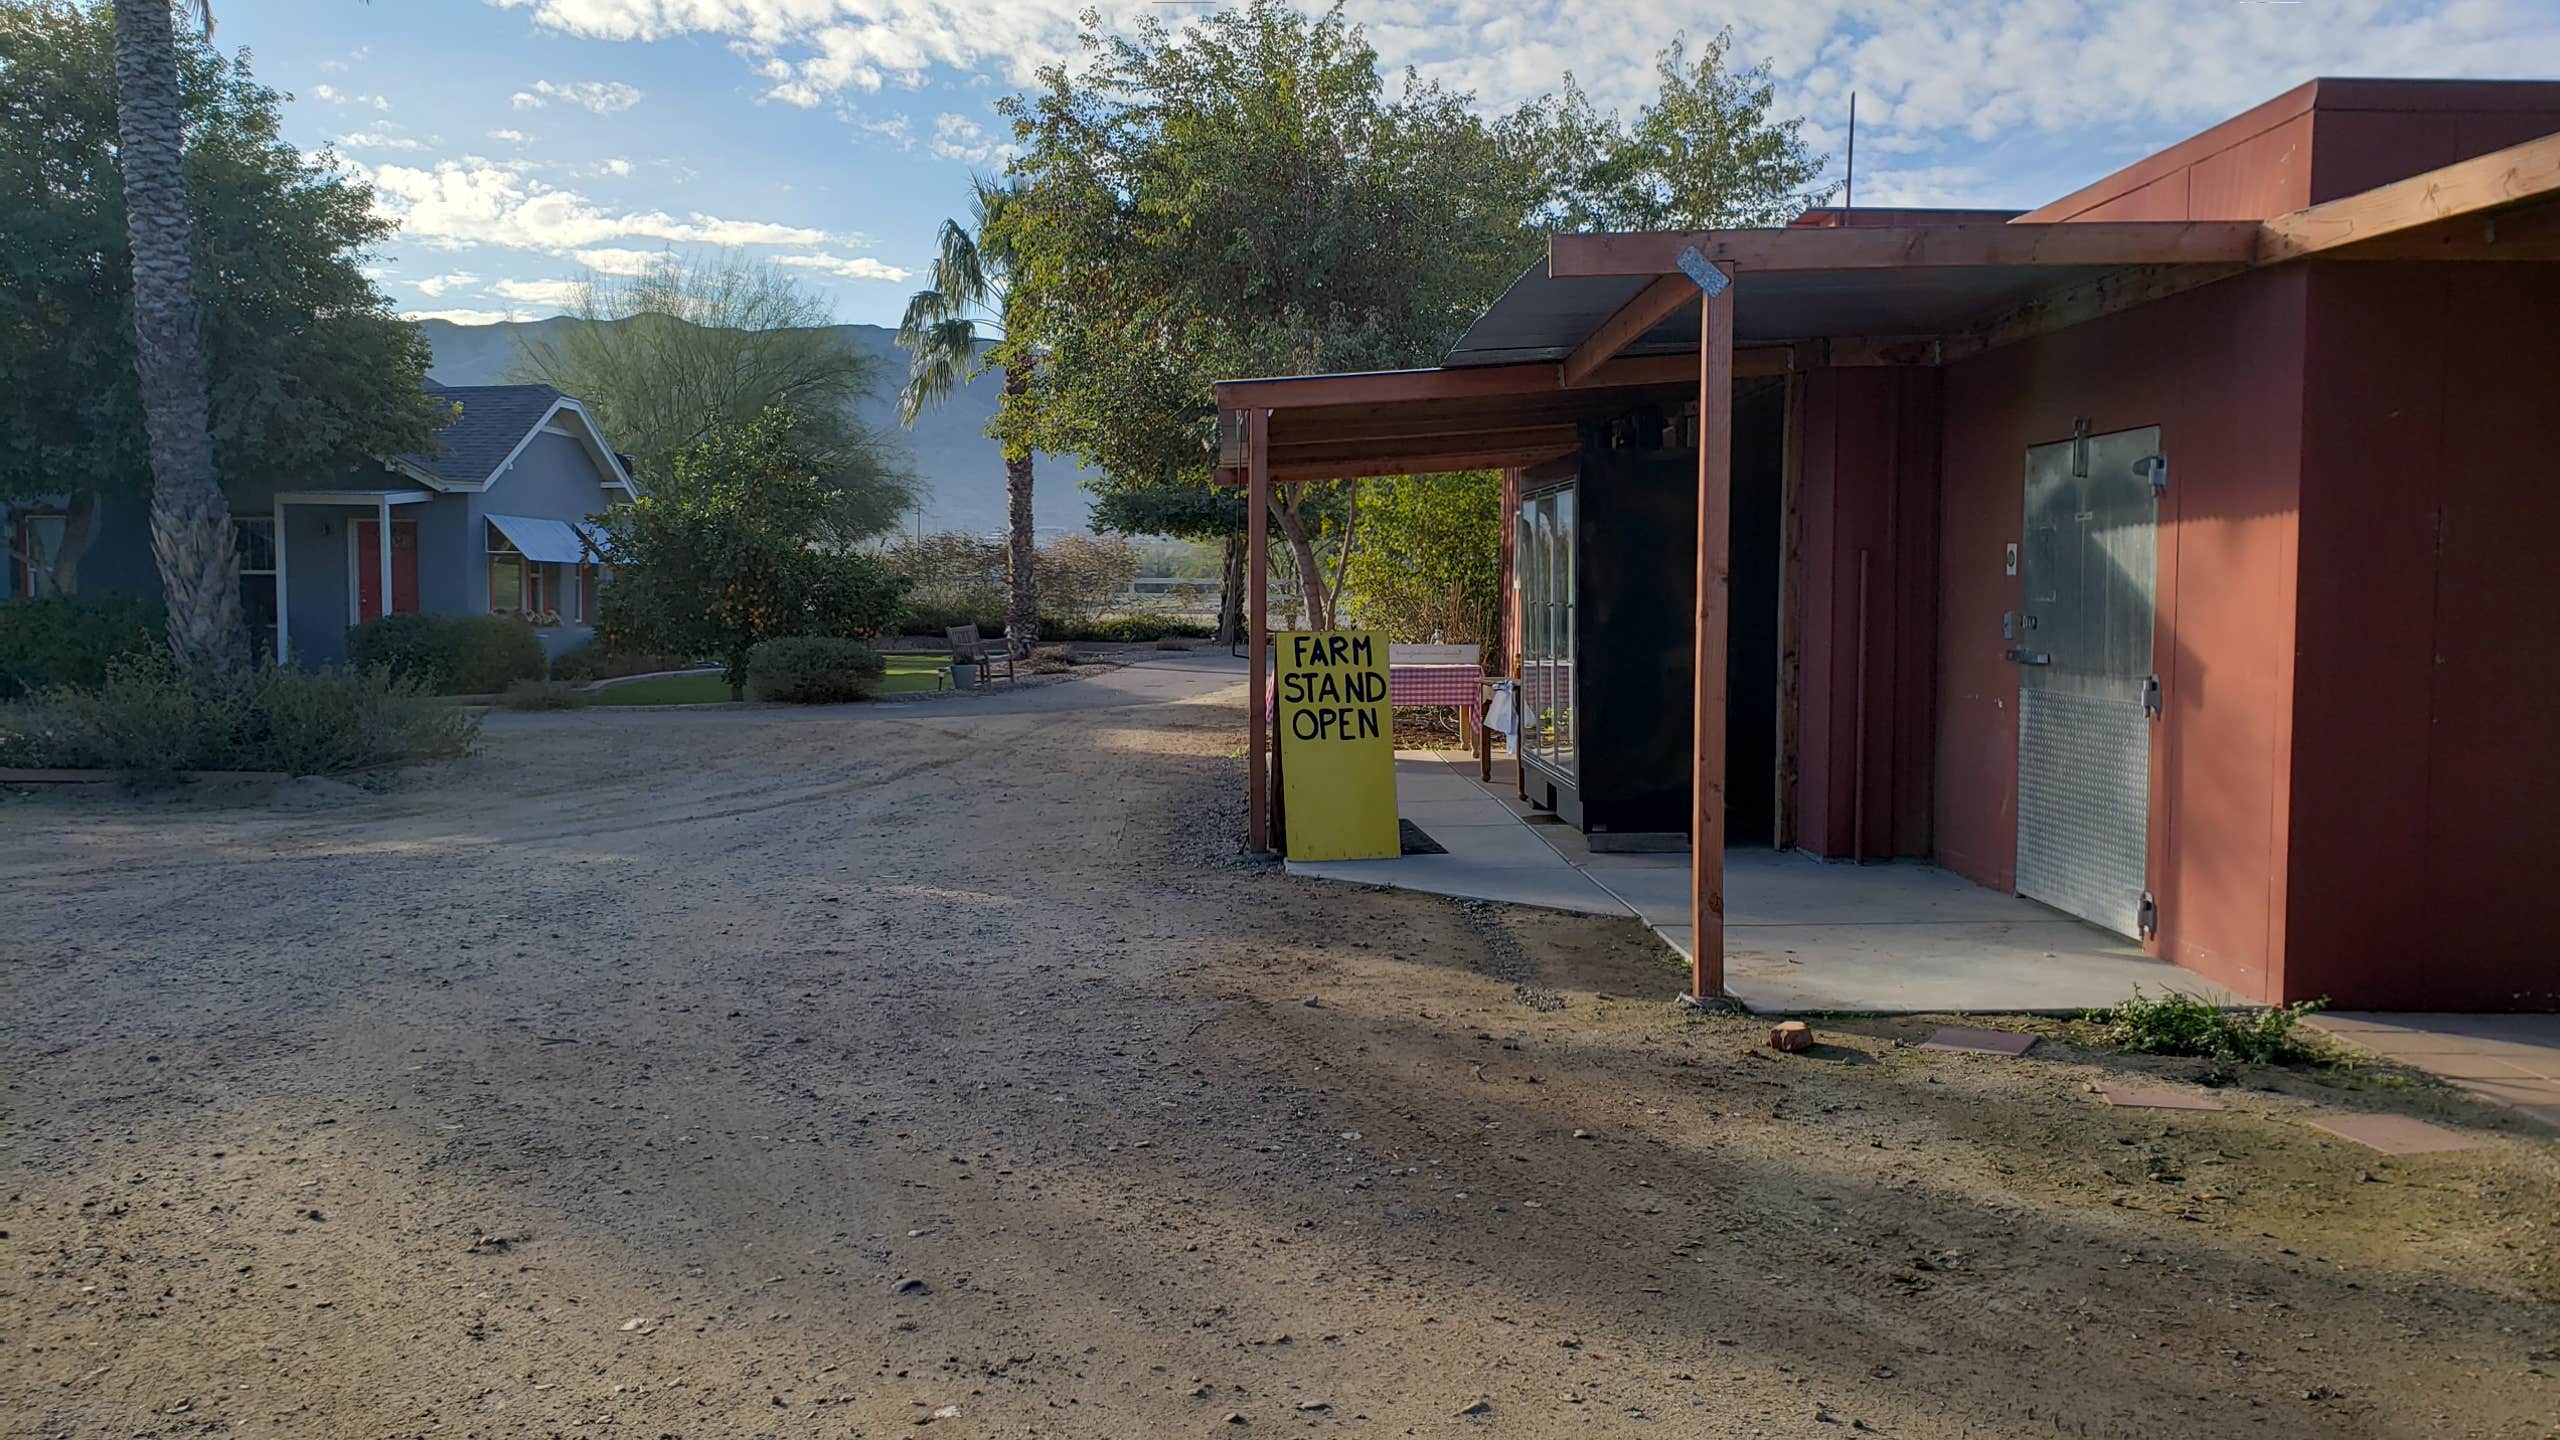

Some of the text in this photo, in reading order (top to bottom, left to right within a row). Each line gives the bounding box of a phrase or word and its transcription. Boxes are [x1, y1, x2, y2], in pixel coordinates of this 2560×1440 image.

[1293, 635, 1373, 668] FARM
[1283, 671, 1387, 704] STAND
[1292, 707, 1380, 741] OPEN
